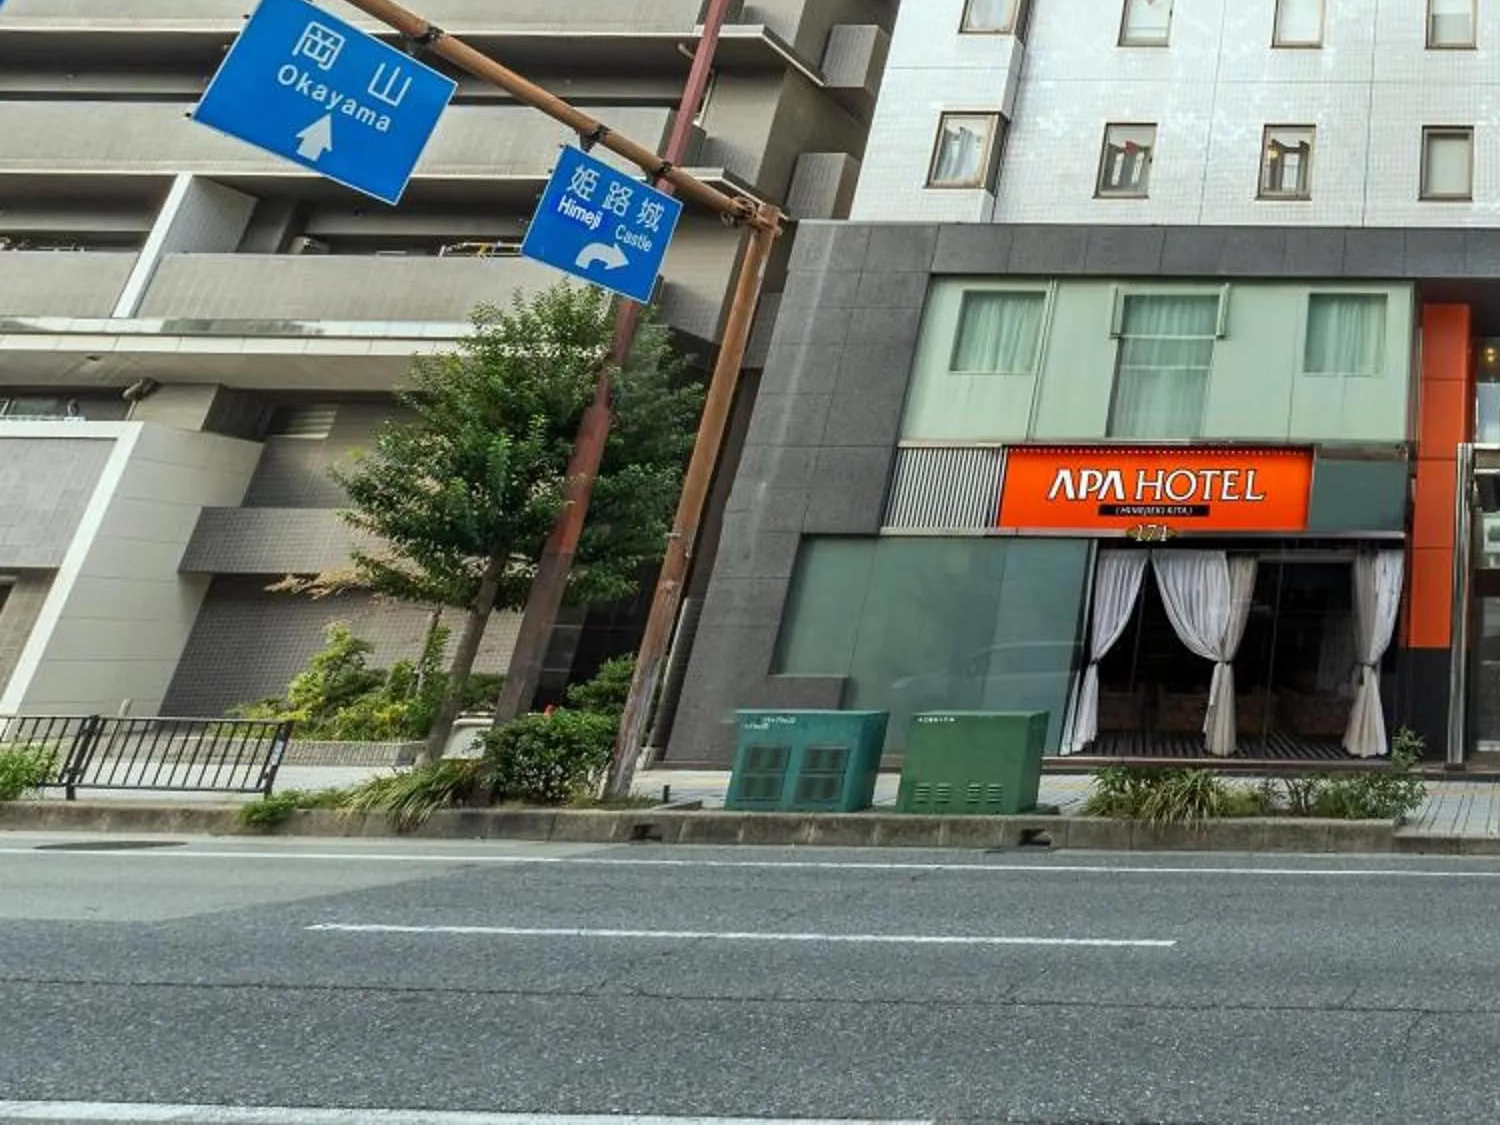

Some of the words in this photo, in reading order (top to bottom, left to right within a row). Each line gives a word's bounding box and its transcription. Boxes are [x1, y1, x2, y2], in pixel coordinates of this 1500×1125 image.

[292, 21, 412, 107] 岡山
[277, 64, 391, 133] Okayama
[557, 194, 604, 230] Himeji
[566, 165, 665, 233] 姫路城
[615, 224, 653, 252] Castle
[1048, 469, 1126, 501] APA
[1135, 469, 1265, 501] HOTEL
